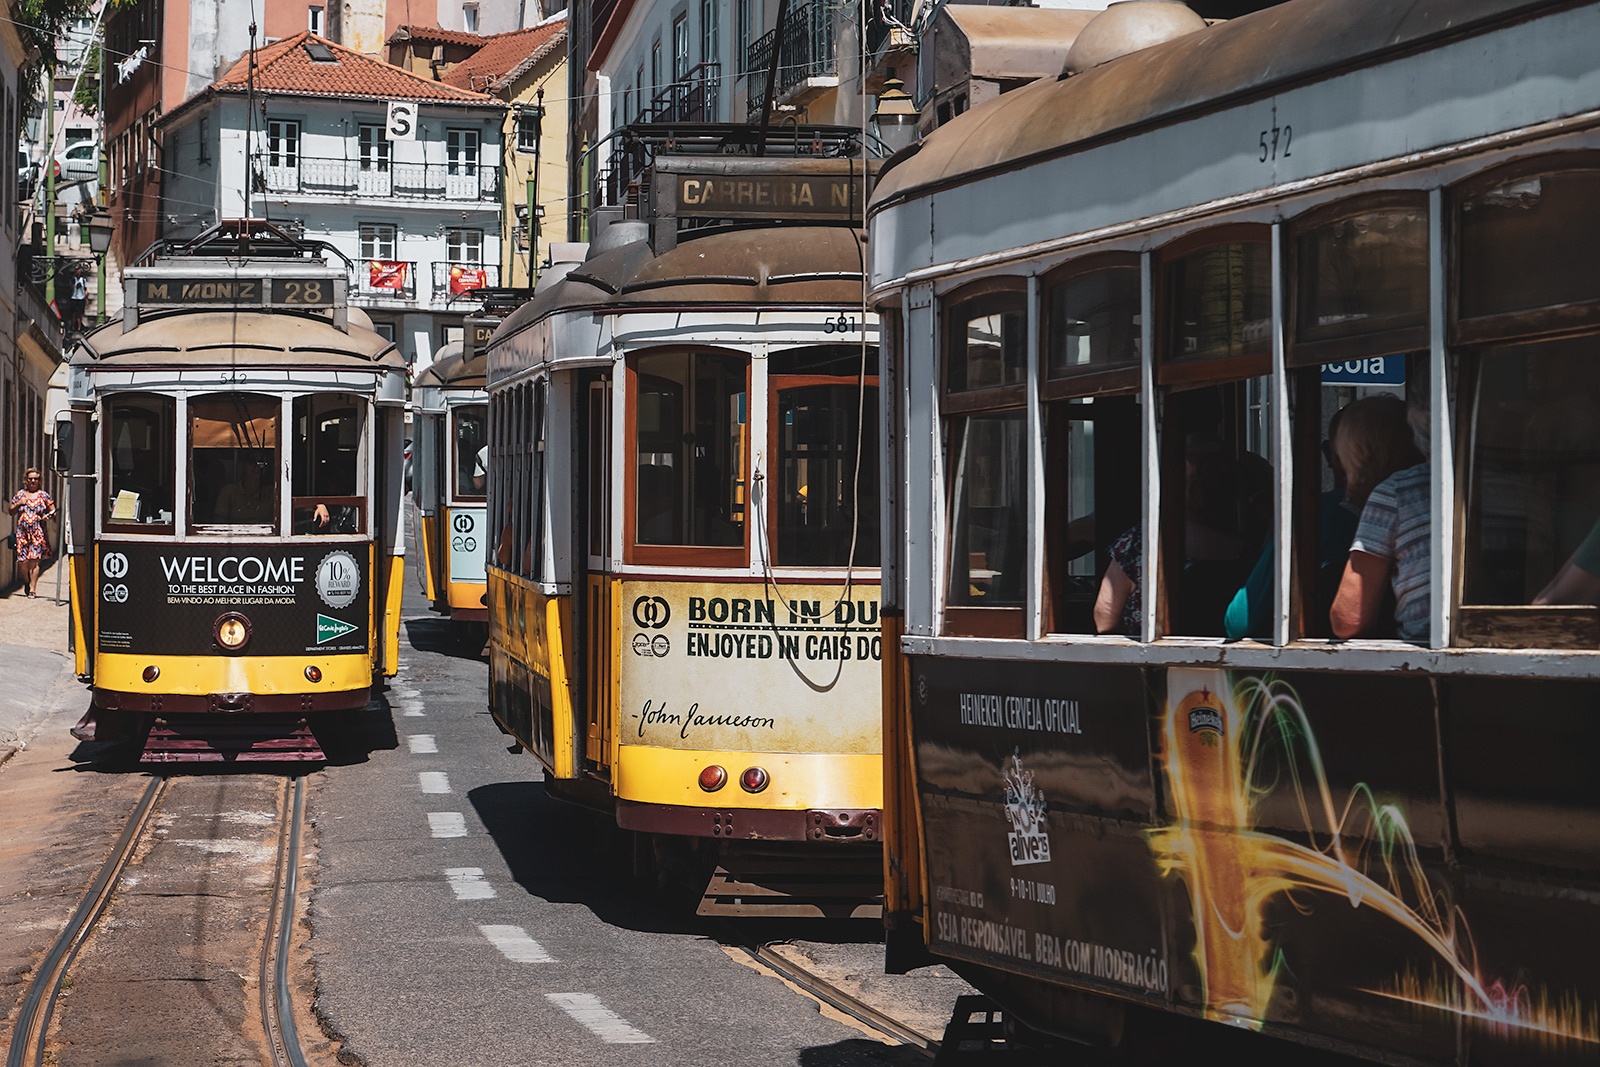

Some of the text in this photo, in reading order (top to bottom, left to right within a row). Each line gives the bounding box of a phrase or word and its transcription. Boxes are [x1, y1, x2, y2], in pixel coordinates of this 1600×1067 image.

[390, 106, 411, 137] S
[1259, 124, 1293, 163] 572
[148, 282, 255, 299] M. MONIZ
[284, 280, 322, 303] 28
[476, 329, 496, 341] CA
[823, 316, 856, 334] 581
[219, 373, 248, 385] 542
[159, 556, 304, 583] WELCOME
[167, 596, 296, 605] BEM-VINDO AO MELHOR LUGAR DA MODA
[168, 585, 295, 594] TO THE BEST PLACE IN FASHION
[688, 597, 775, 625] BORN
[789, 599, 821, 625] IN
[686, 632, 773, 659] ENJOYED
[778, 634, 800, 660] IN
[805, 634, 852, 661] CAIS
[680, 703, 774, 739] Jameson
[959, 693, 1082, 735] HEINEKEN CERVEJA OFICIAL
[1036, 882, 1056, 906] JULHO
[937, 911, 959, 945] SEJA
[960, 917, 1032, 962] RESPONSÁVEL.
[1035, 932, 1062, 968] BEBA
[1064, 939, 1091, 974] COM
